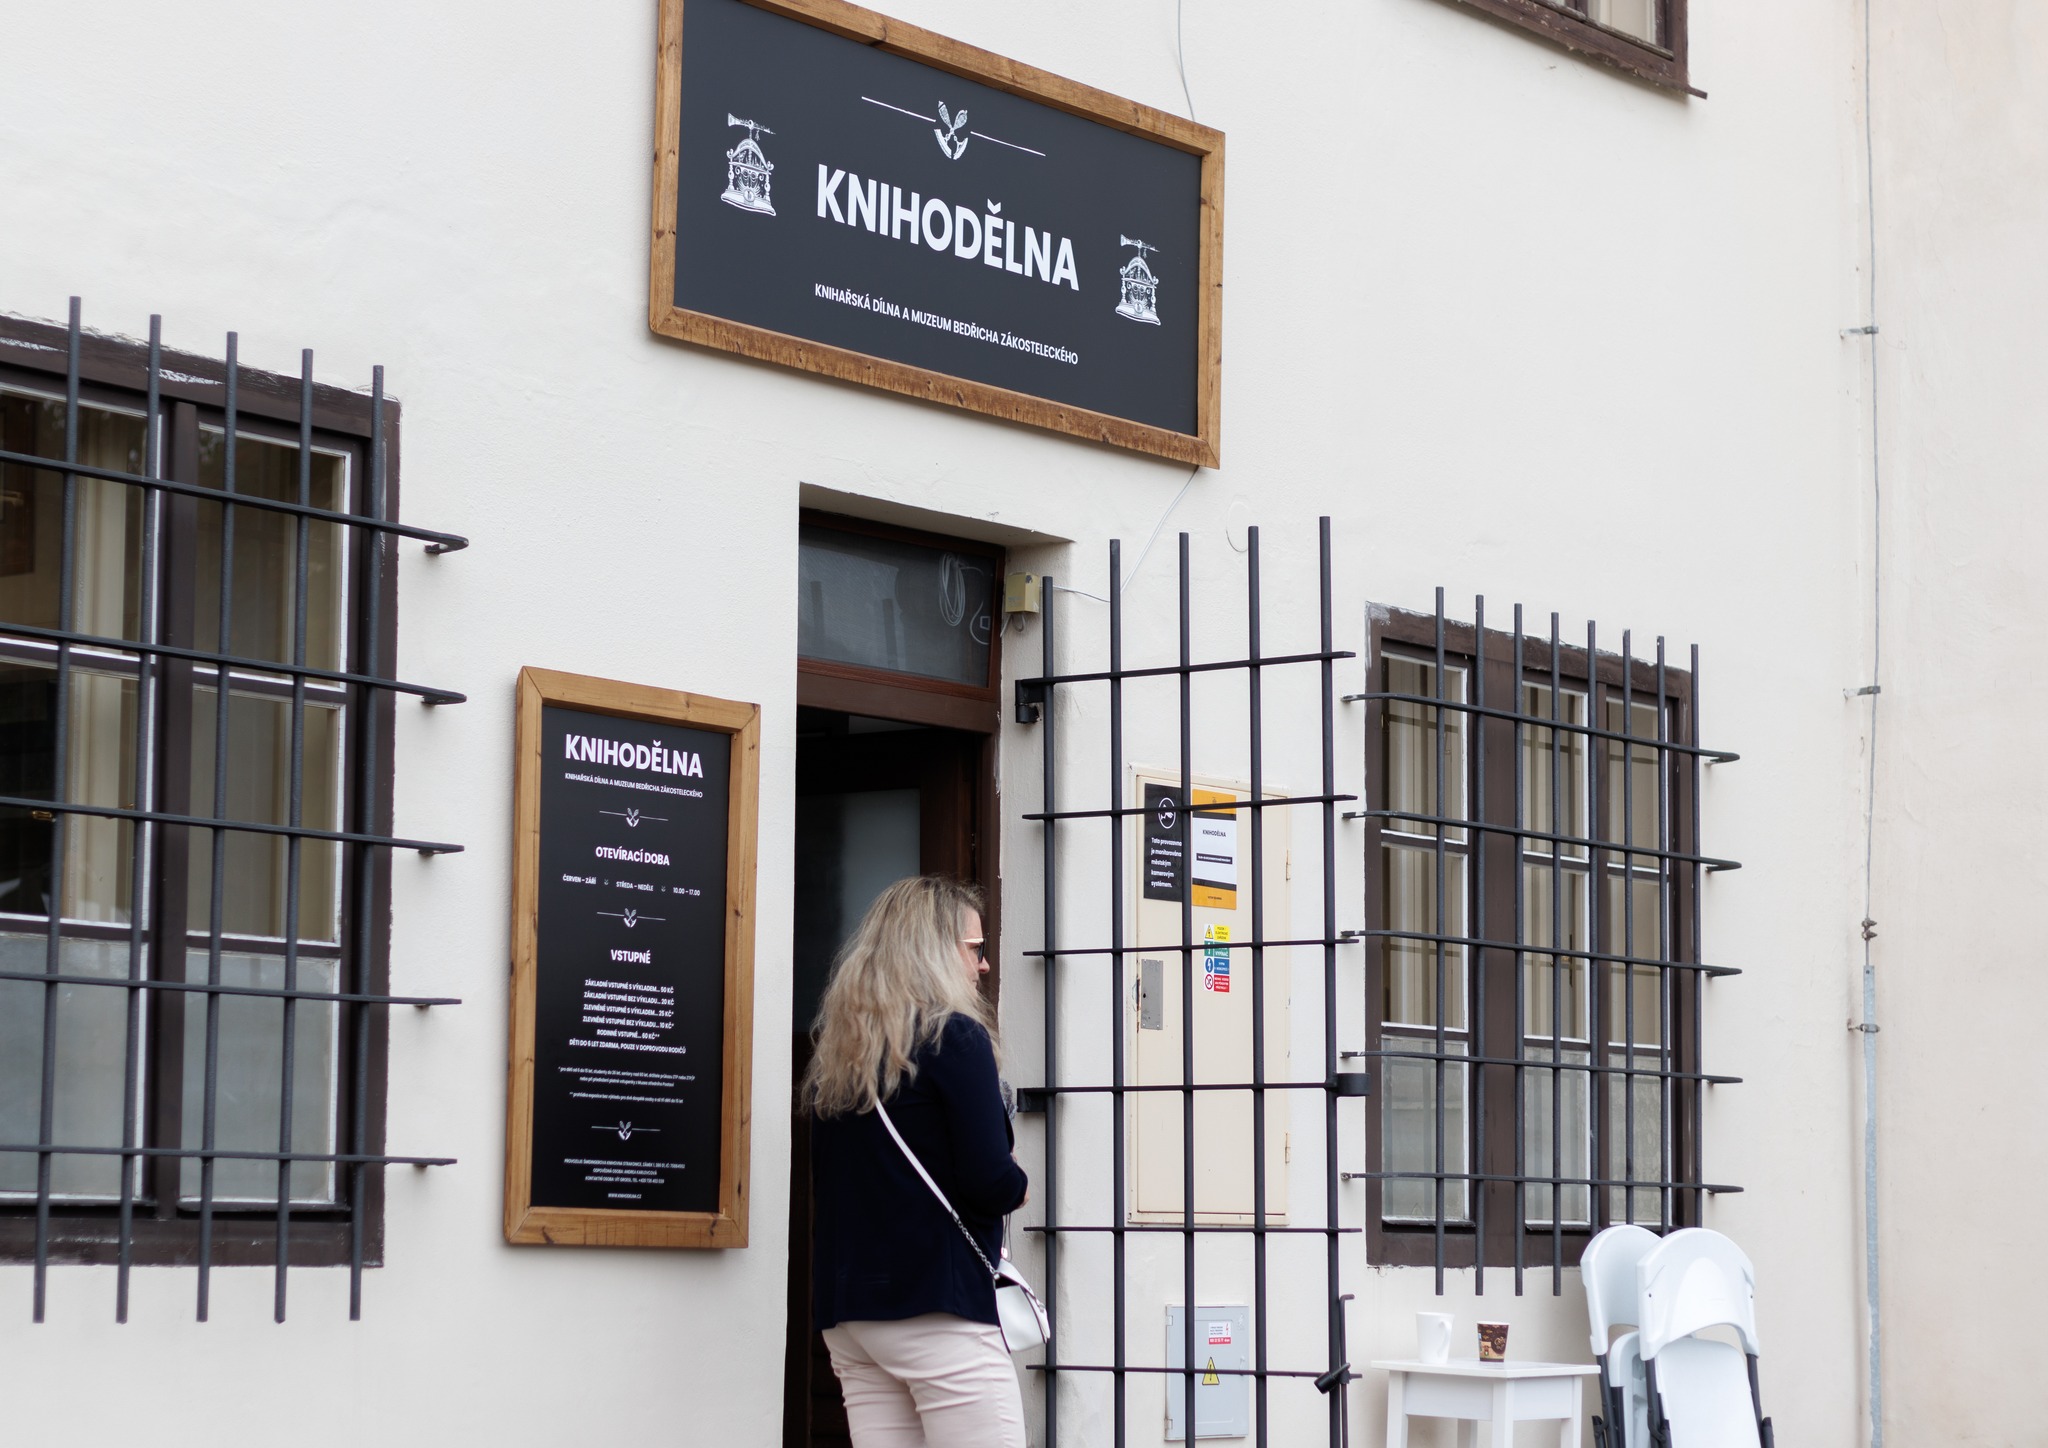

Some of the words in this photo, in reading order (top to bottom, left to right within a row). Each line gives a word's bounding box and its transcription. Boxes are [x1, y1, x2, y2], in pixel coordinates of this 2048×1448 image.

[817, 164, 1080, 291] KNIHODĚLNA
[815, 283, 871, 310] KNIHAŘSKÁ
[873, 298, 900, 318] DÍLNA
[902, 307, 910, 320] A
[911, 309, 952, 331] MUZEUM
[953, 321, 999, 344] BEDŘICHA
[1001, 332, 1078, 364] ZÁKOSTELECKÉHO
[565, 734, 704, 778] KNIHODĚLNA
[565, 773, 593, 782] KNIHAŘSKÁ
[594, 776, 609, 784] DÍLNA
[614, 780, 635, 788] MUZEUM
[636, 783, 660, 791] BEDŘICHA
[661, 785, 703, 798] ZÁKOSTELECKÉHO
[1203, 829, 1227, 838] KNIHODĚLNA
[596, 846, 643, 862] OTEVÍRACÍ
[645, 852, 670, 865] DOBA
[1151, 859, 1171, 867] městským
[563, 874, 581, 882] ČERVEN
[1151, 870, 1174, 878] kamerovým
[611, 949, 650, 964] VSTUPNÉ
[585, 979, 608, 987] ZÁKLADNÍ
[584, 991, 606, 999] ZÁKLADNÍ
[570, 1038, 580, 1046] DĚTI
[600, 1041, 620, 1049] ZDARMA,
[640, 1044, 668, 1052] DOPROVODU
